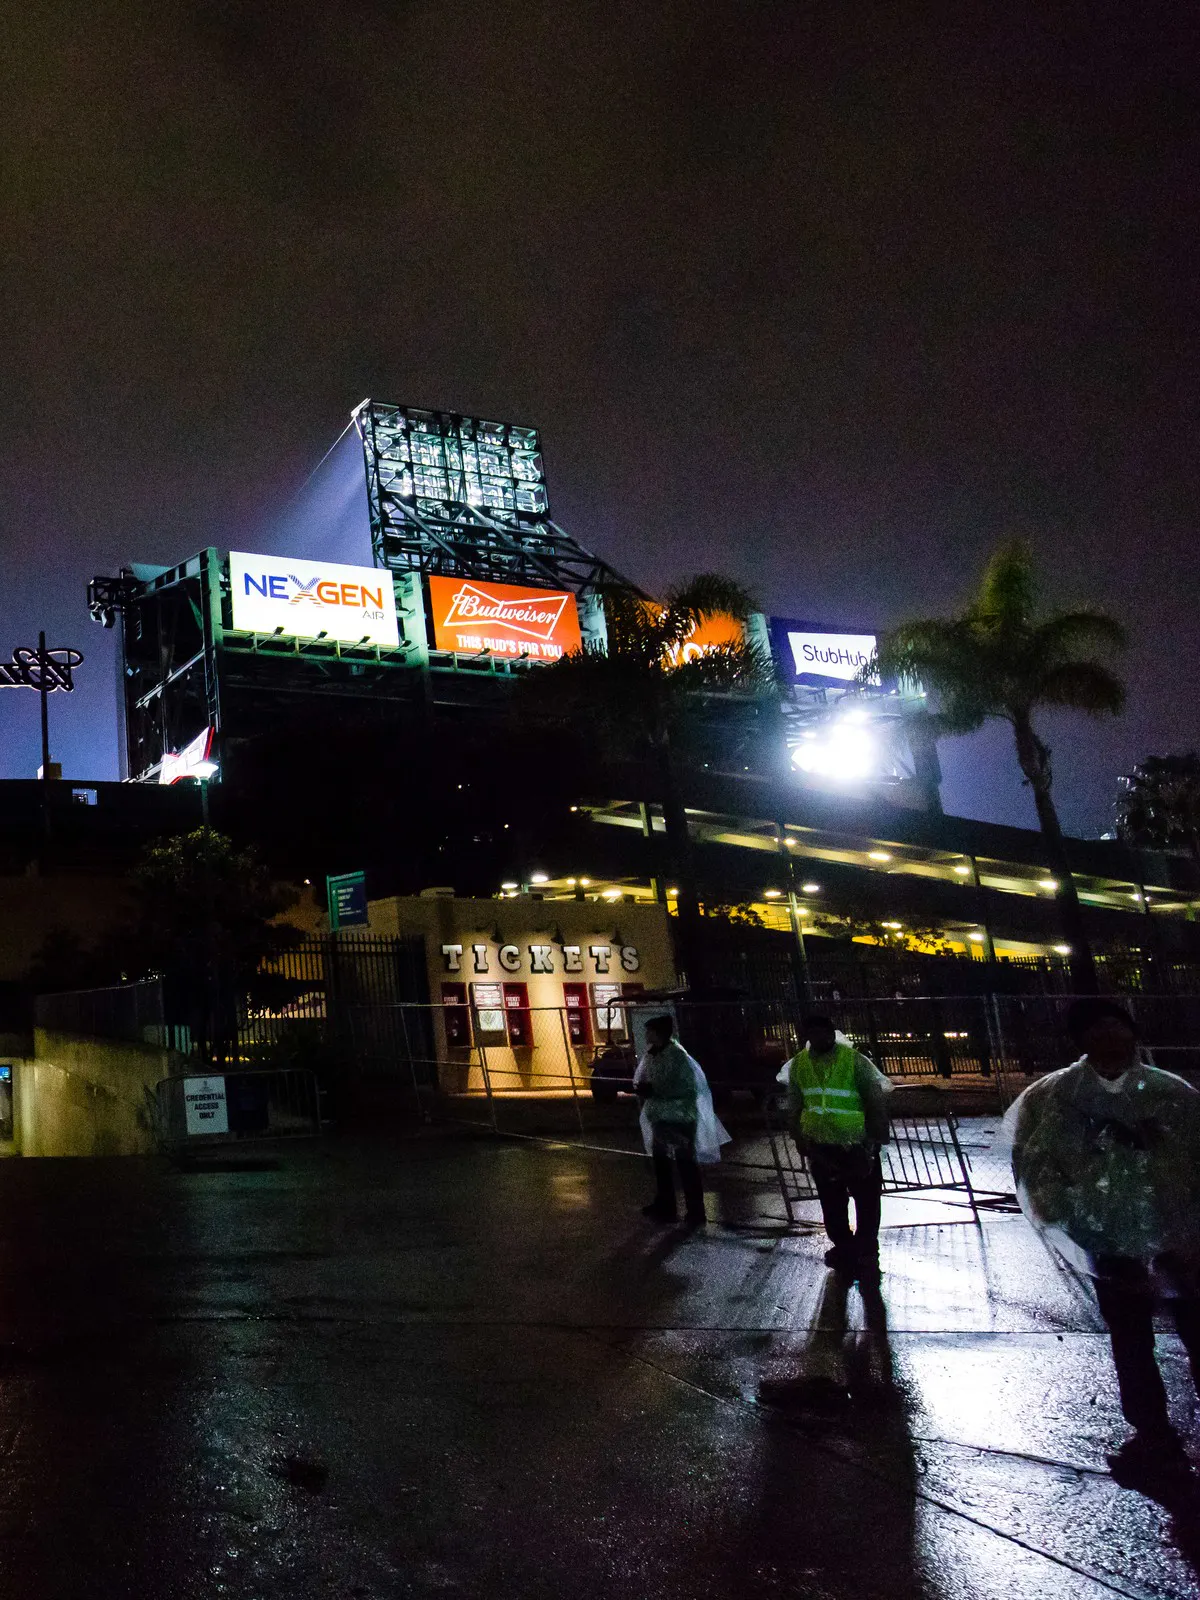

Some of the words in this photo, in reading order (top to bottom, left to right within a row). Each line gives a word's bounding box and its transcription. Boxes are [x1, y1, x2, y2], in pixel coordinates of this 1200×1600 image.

[244, 572, 383, 609] NEXGEN
[362, 610, 385, 621] AIR
[453, 591, 557, 624] Budweiser
[456, 635, 482, 650] THIS
[517, 640, 540, 656] FOR
[540, 643, 563, 659] YOU
[802, 645, 869, 667] StubHub
[442, 943, 641, 974] TICKETS
[186, 1093, 225, 1102] CREDENTIAL
[194, 1102, 219, 1110] ACCESS
